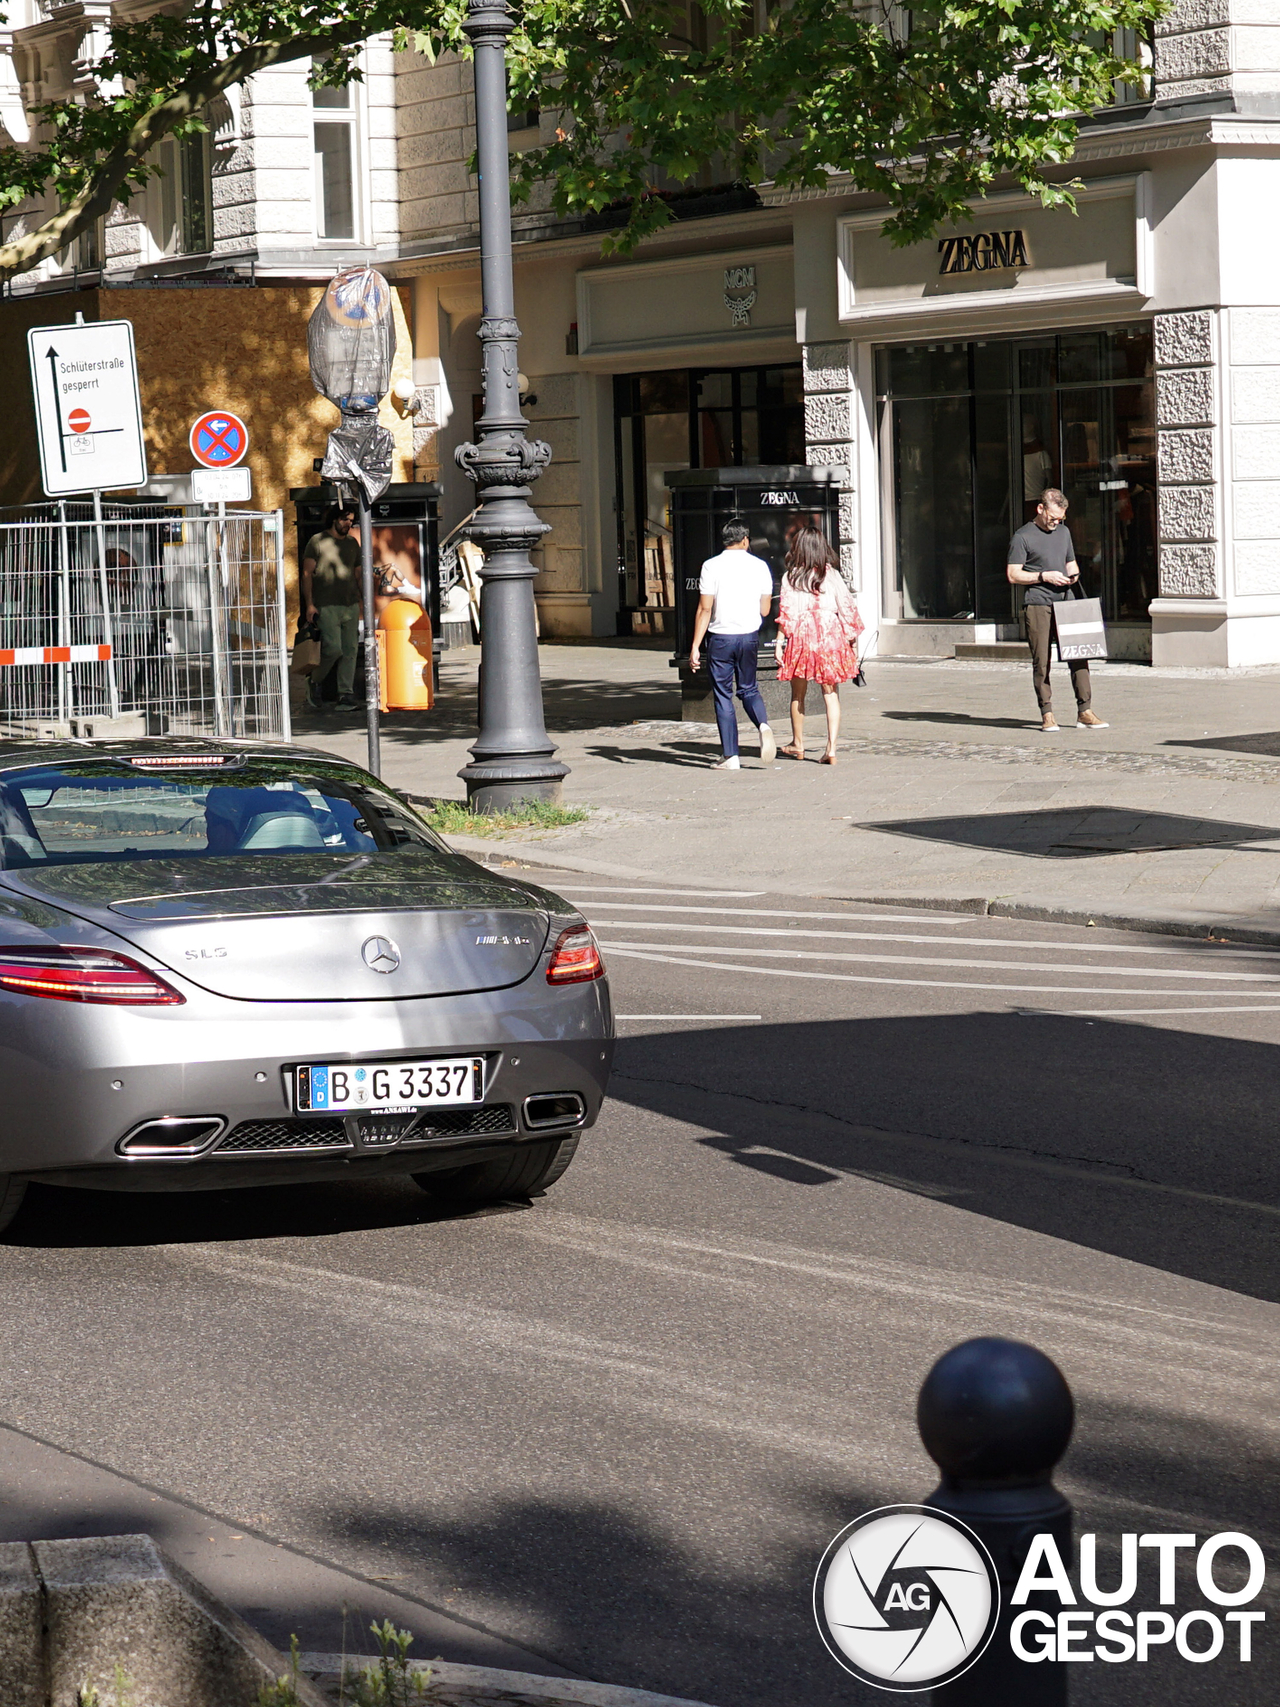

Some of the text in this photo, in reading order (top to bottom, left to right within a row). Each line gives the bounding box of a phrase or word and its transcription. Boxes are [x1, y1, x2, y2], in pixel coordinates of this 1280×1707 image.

[938, 230, 1030, 274] ZEGNA
[723, 267, 755, 289] MCM
[60, 357, 125, 374] Schlüterstraße
[62, 378, 99, 394] gesperrt
[760, 491, 800, 505] ZEGNA
[1062, 643, 1107, 659] ZEGNA
[185, 947, 228, 960] SLS
[332, 1072, 350, 1102] B
[372, 1069, 390, 1100] G
[398, 1066, 468, 1098] 3337
